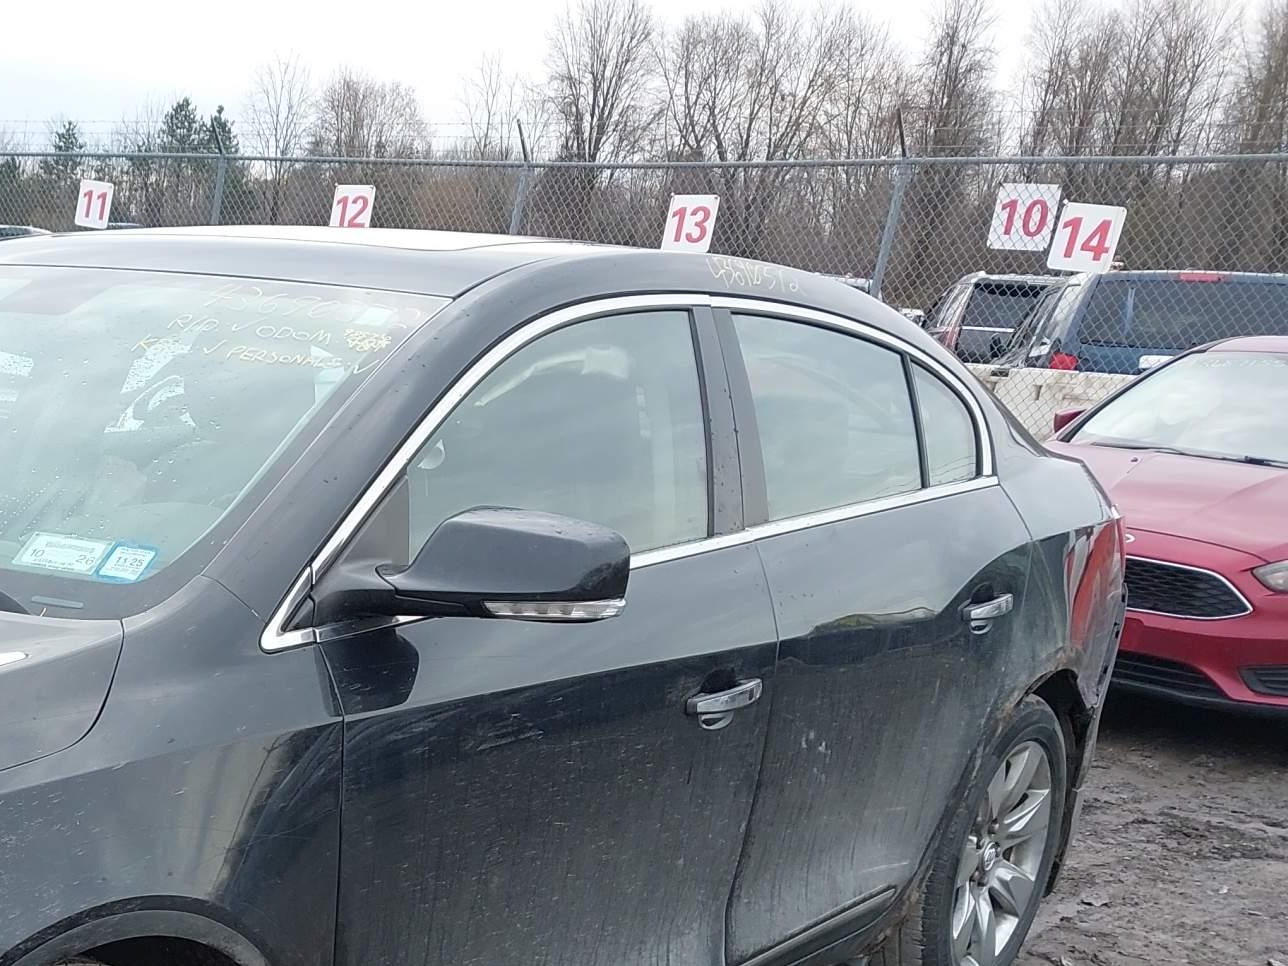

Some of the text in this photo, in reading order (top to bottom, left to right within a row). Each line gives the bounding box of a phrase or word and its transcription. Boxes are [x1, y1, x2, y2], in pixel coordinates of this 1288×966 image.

[82, 189, 108, 221] 11
[336, 195, 368, 228] 12
[1000, 199, 1050, 239] 10
[671, 206, 711, 244] 13
[1062, 216, 1114, 263] 14
